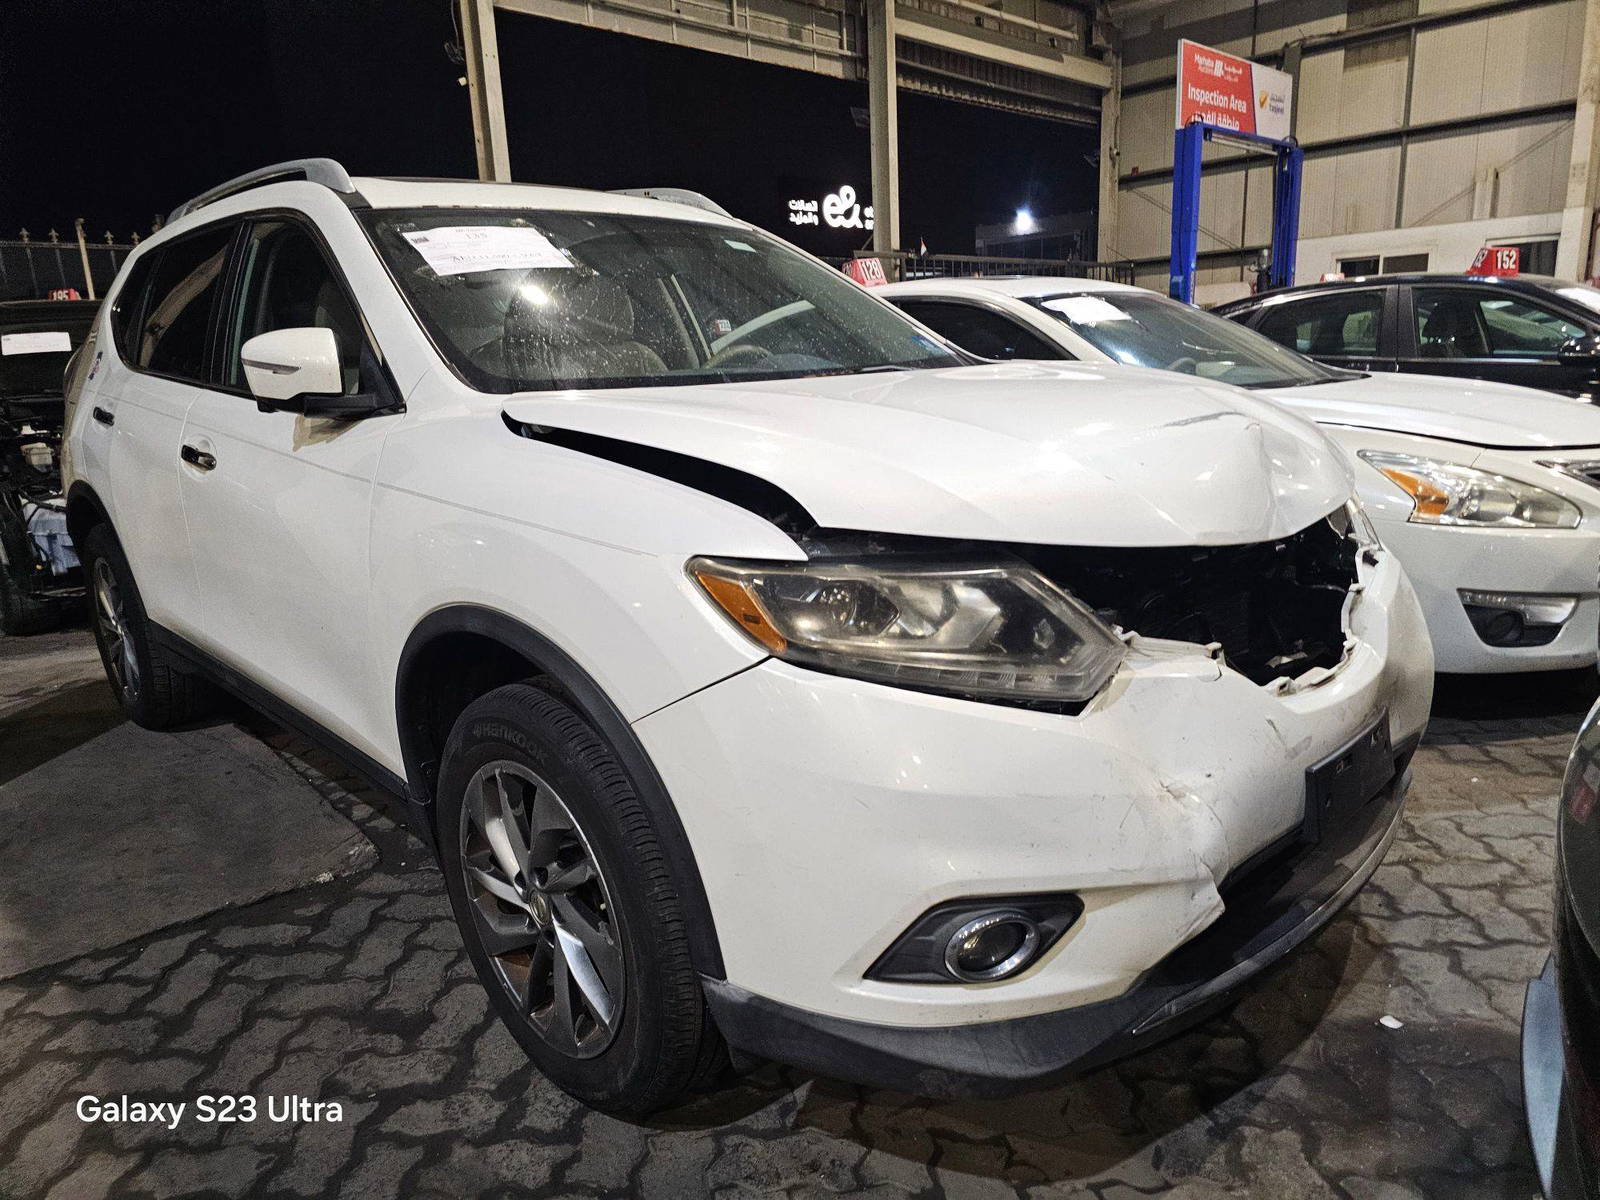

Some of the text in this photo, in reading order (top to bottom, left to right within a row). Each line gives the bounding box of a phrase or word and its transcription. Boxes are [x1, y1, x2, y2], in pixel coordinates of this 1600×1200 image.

[1188, 83, 1247, 113] Inspection Area
[1496, 249, 1517, 270] 152
[861, 261, 881, 281] 128
[52, 290, 69, 301] 195
